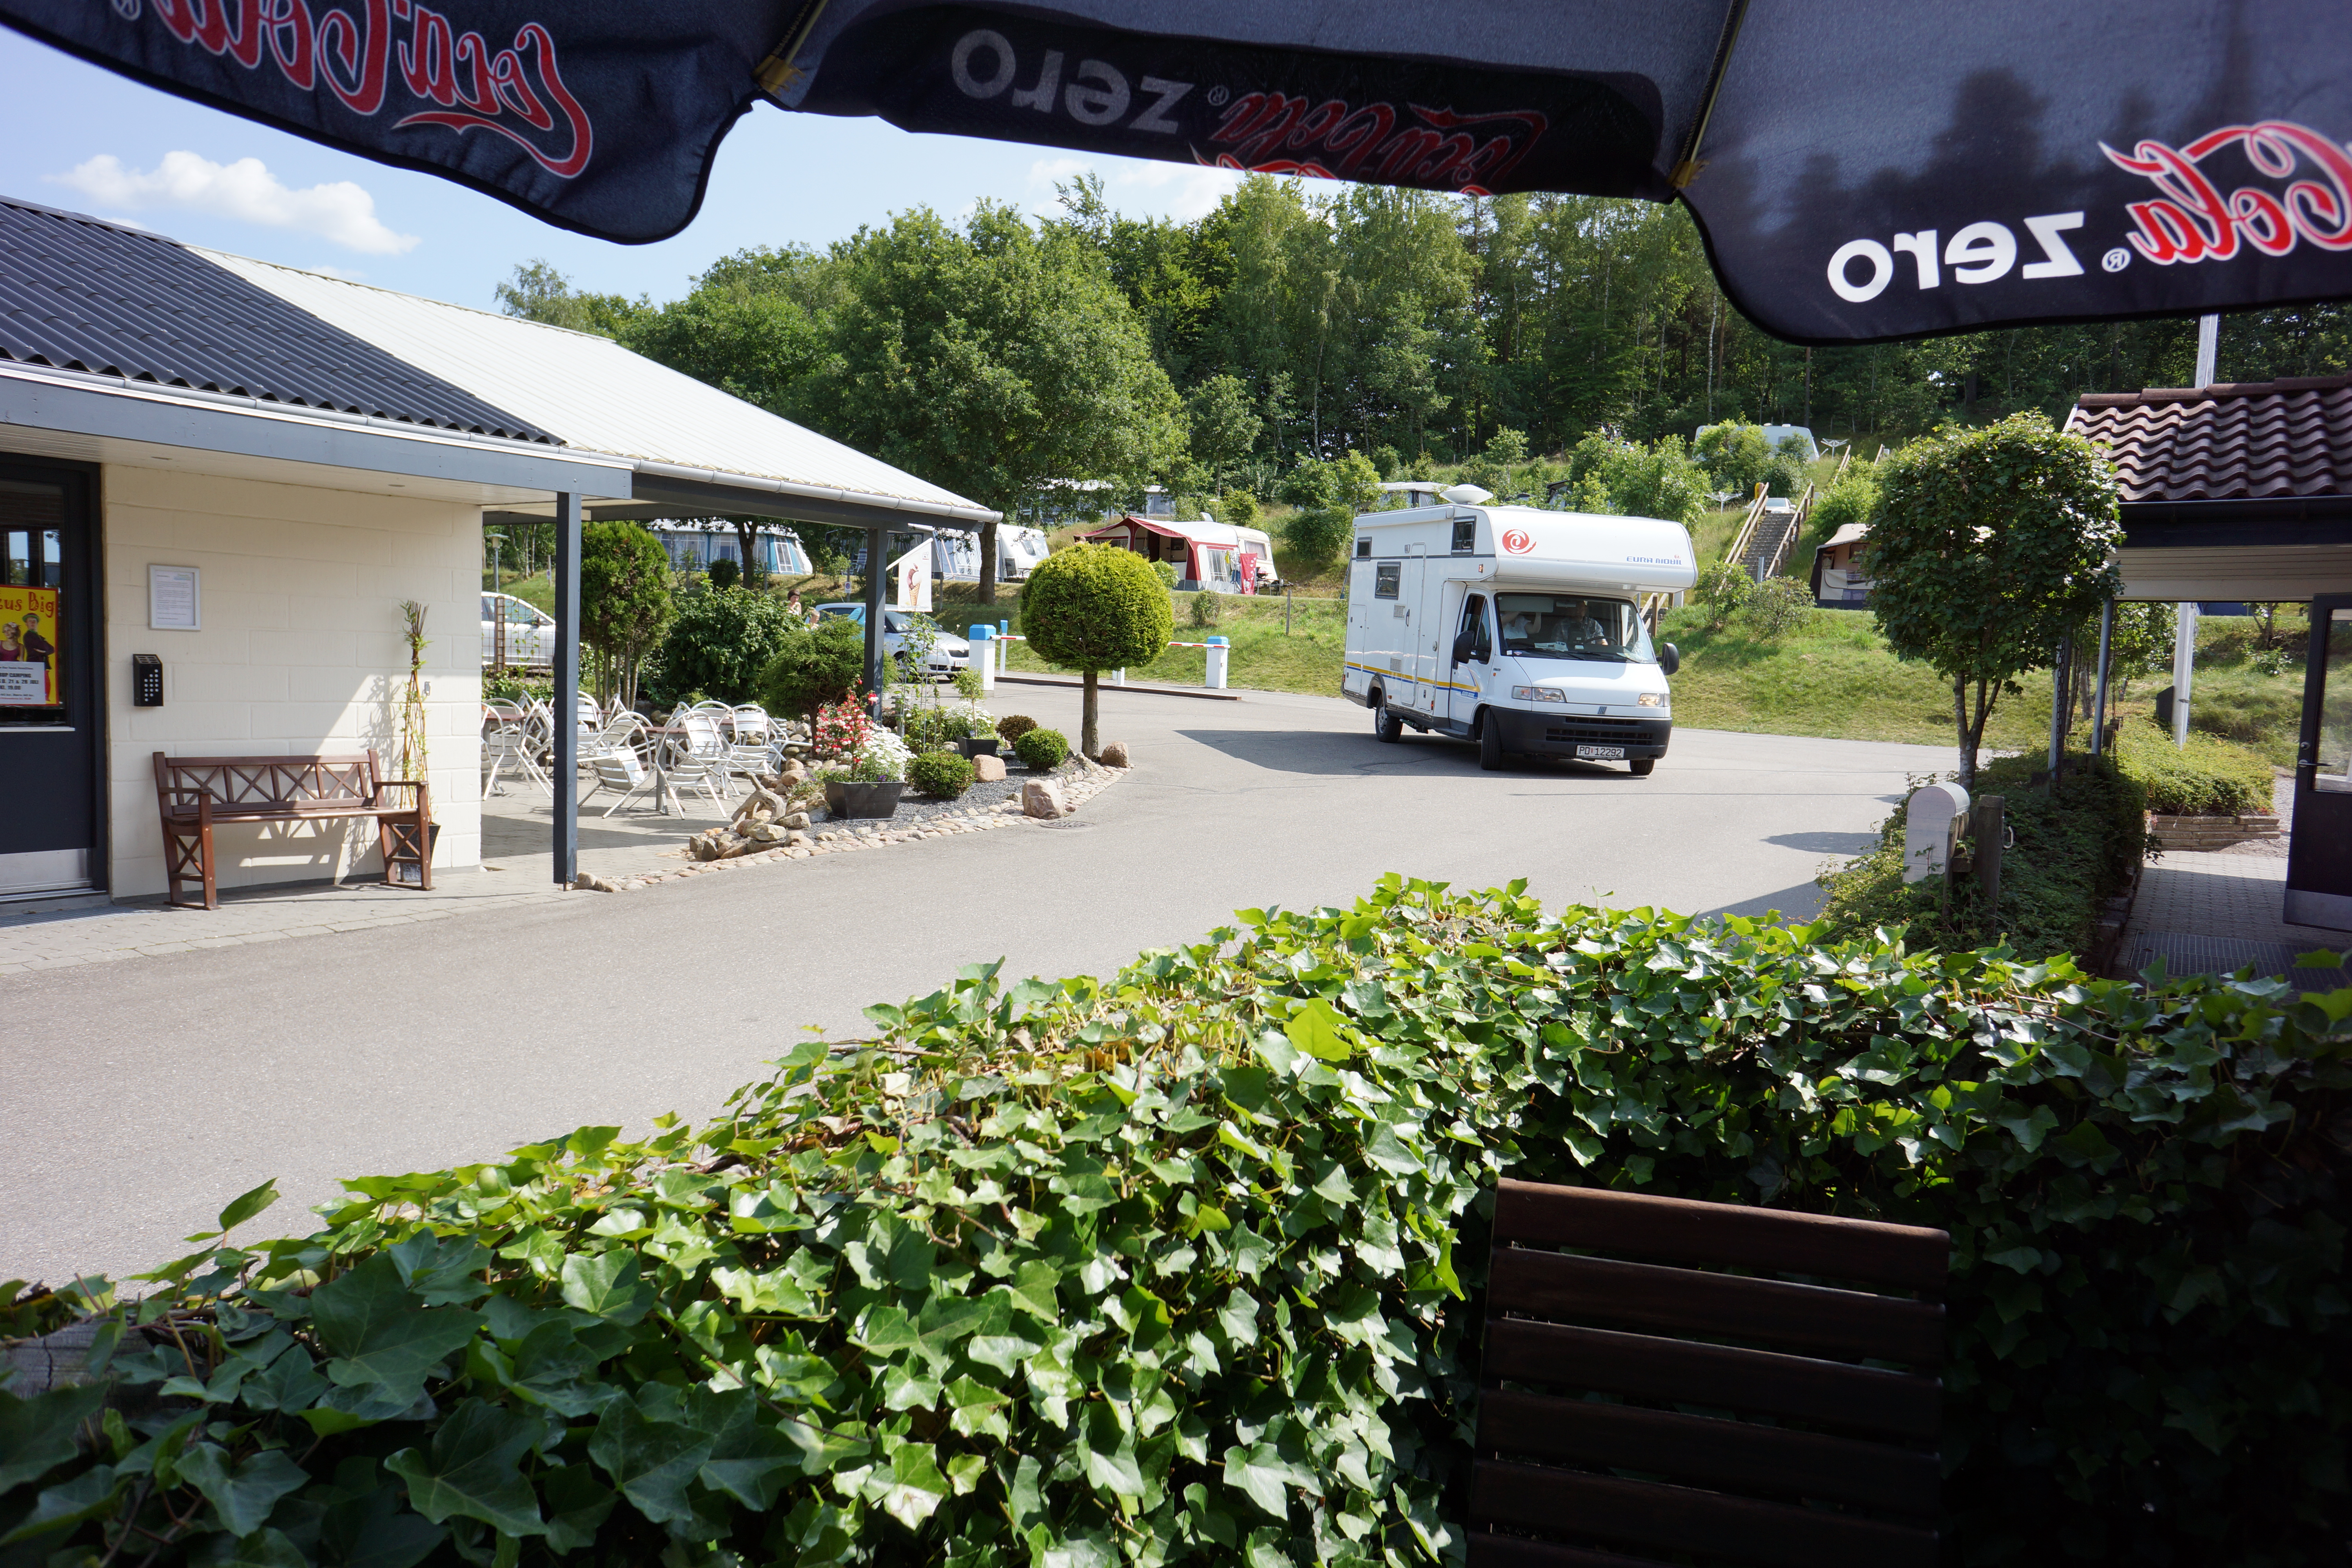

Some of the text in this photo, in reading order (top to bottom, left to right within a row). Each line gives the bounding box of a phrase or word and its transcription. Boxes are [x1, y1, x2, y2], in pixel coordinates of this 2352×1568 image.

[951, 29, 1195, 134] zero
[28, 591, 55, 618] Big
[1579, 746, 1622, 757] PD 12292
